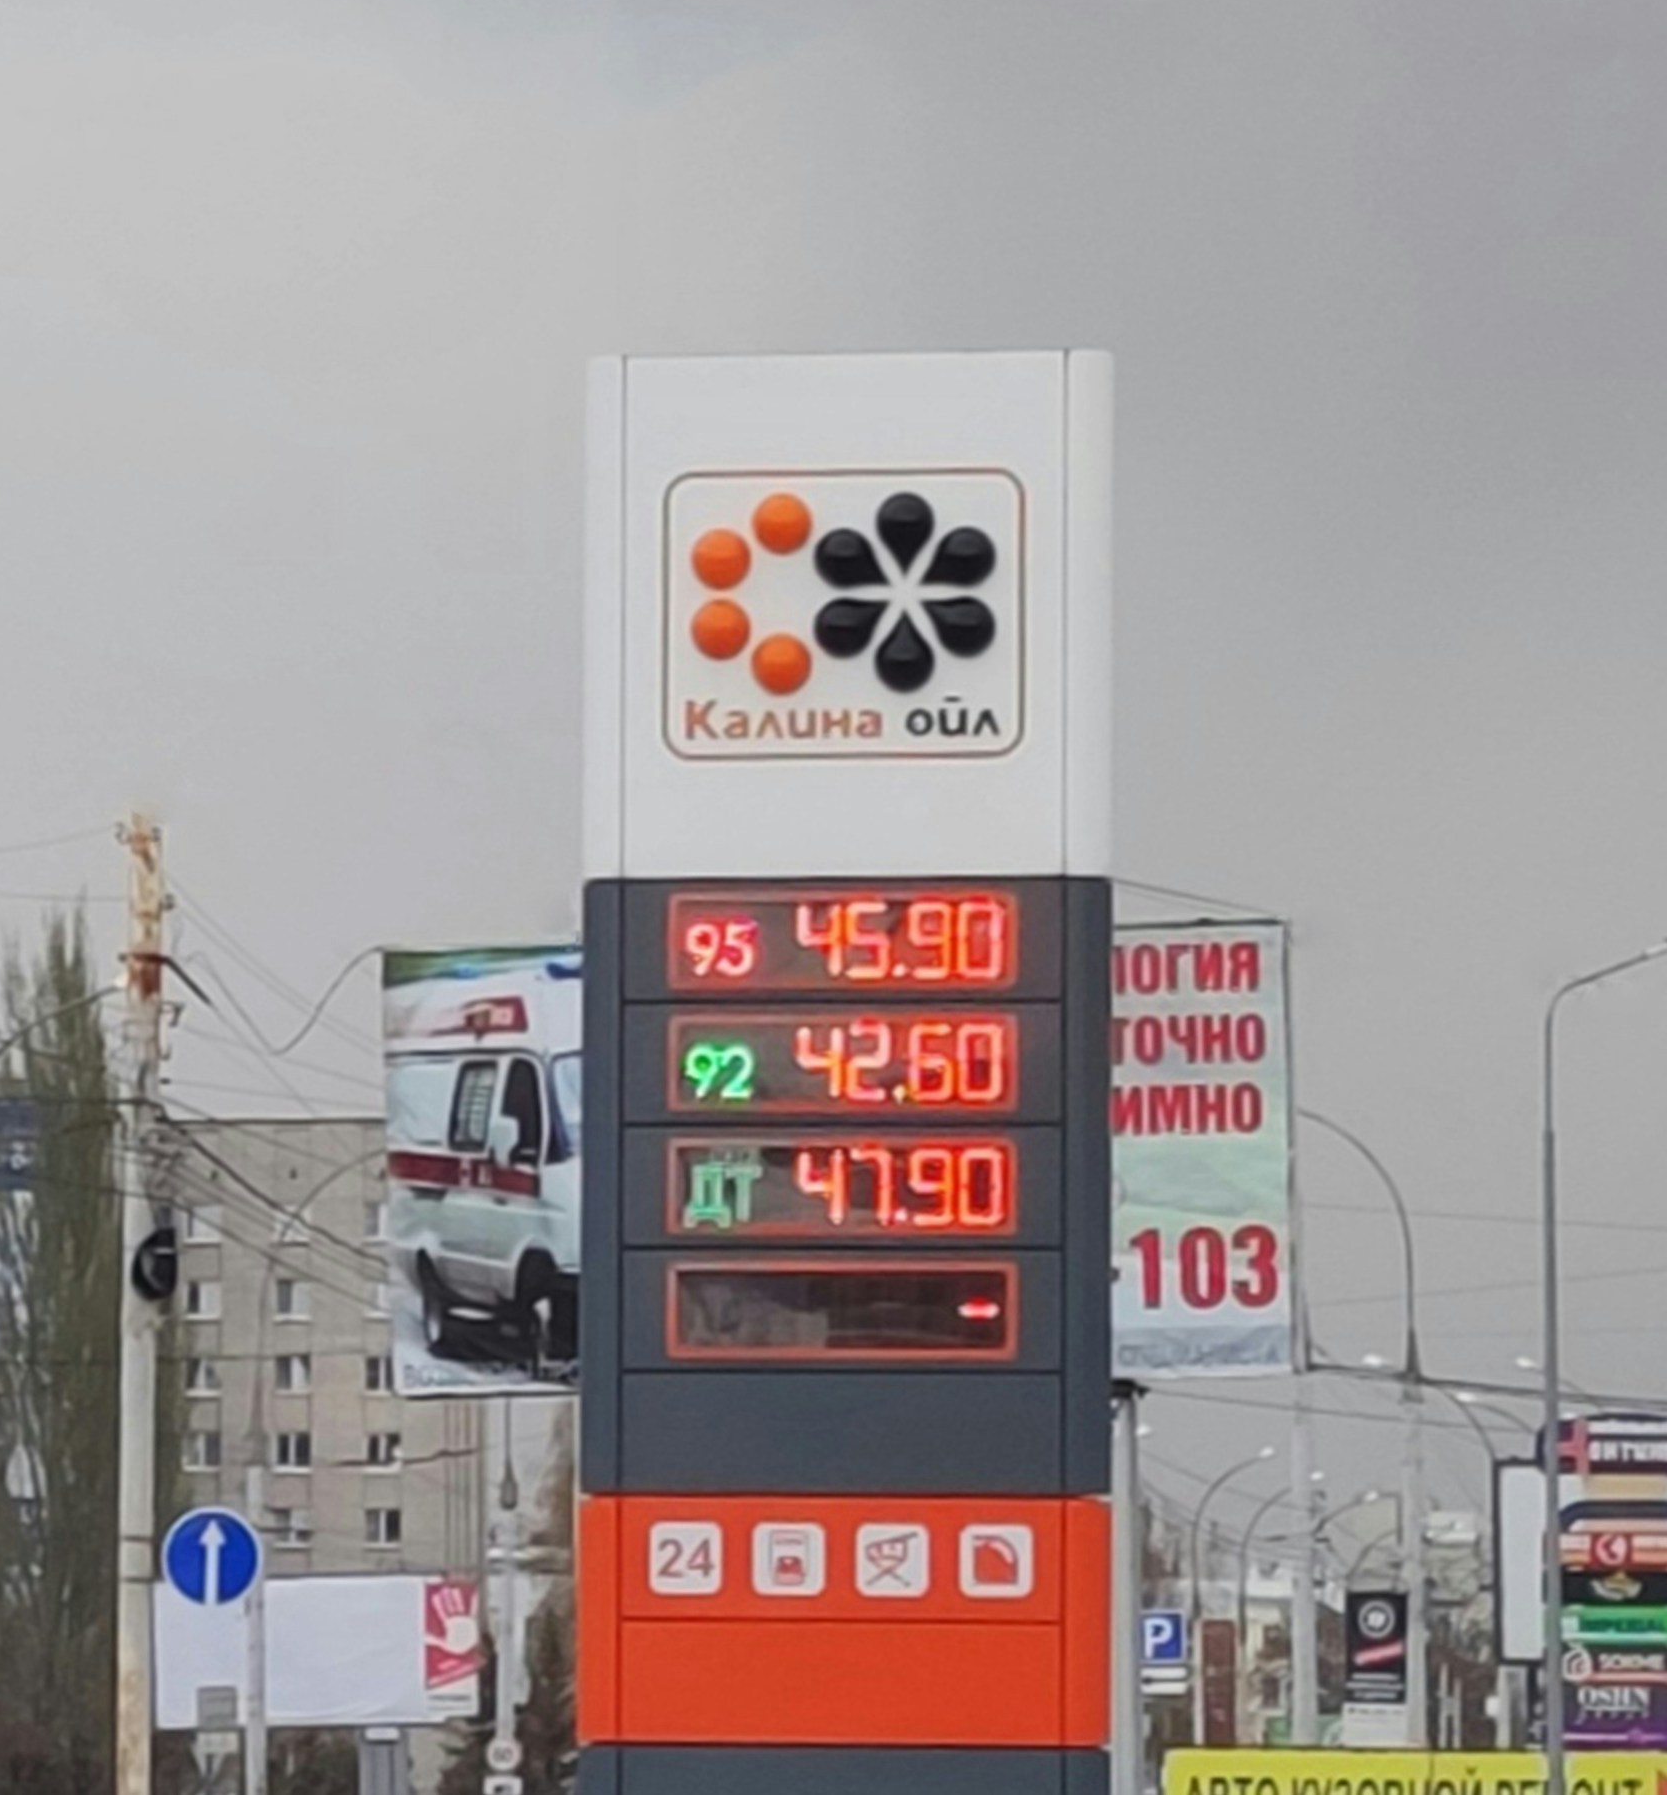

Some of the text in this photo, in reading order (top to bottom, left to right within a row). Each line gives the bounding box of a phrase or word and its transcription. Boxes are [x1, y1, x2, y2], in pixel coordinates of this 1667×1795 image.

[684, 698, 884, 741] Калина
[685, 901, 1005, 979] 95 45.90
[685, 1020, 1005, 1102] 92 42.60
[682, 1146, 1005, 1229] ДТ 47.90
[1128, 1224, 1279, 1310] 103
[656, 1537, 716, 1579] 24
